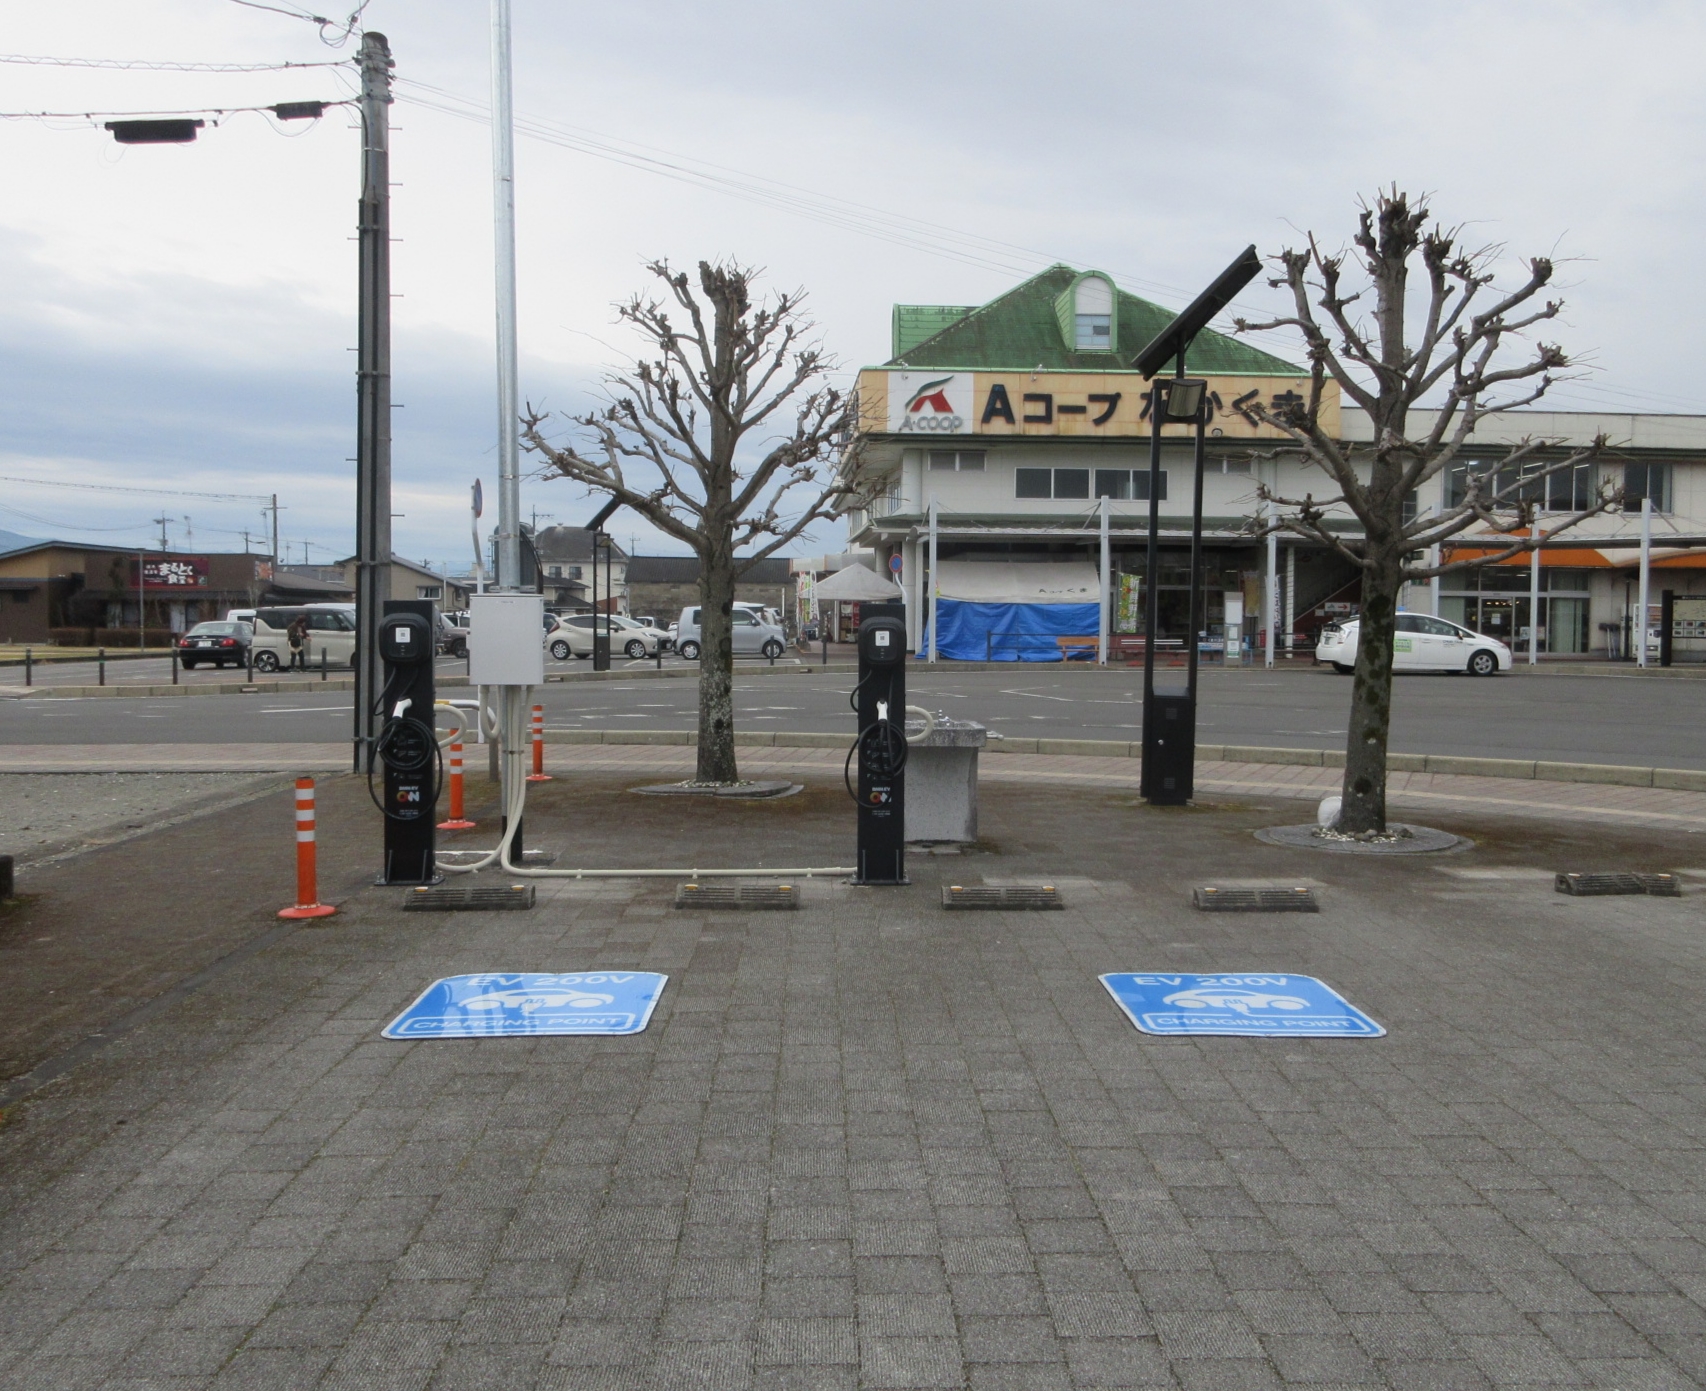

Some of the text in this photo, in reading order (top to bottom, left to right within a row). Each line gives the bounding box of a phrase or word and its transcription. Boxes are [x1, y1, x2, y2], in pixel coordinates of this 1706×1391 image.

[981, 383, 1121, 426] Aコープ
[467, 975, 637, 987] EV 200V
[1132, 976, 1289, 987] EV 200V
[414, 1016, 621, 1029] CHARGING POINT
[1156, 1017, 1352, 1028] CHARGING POINT
